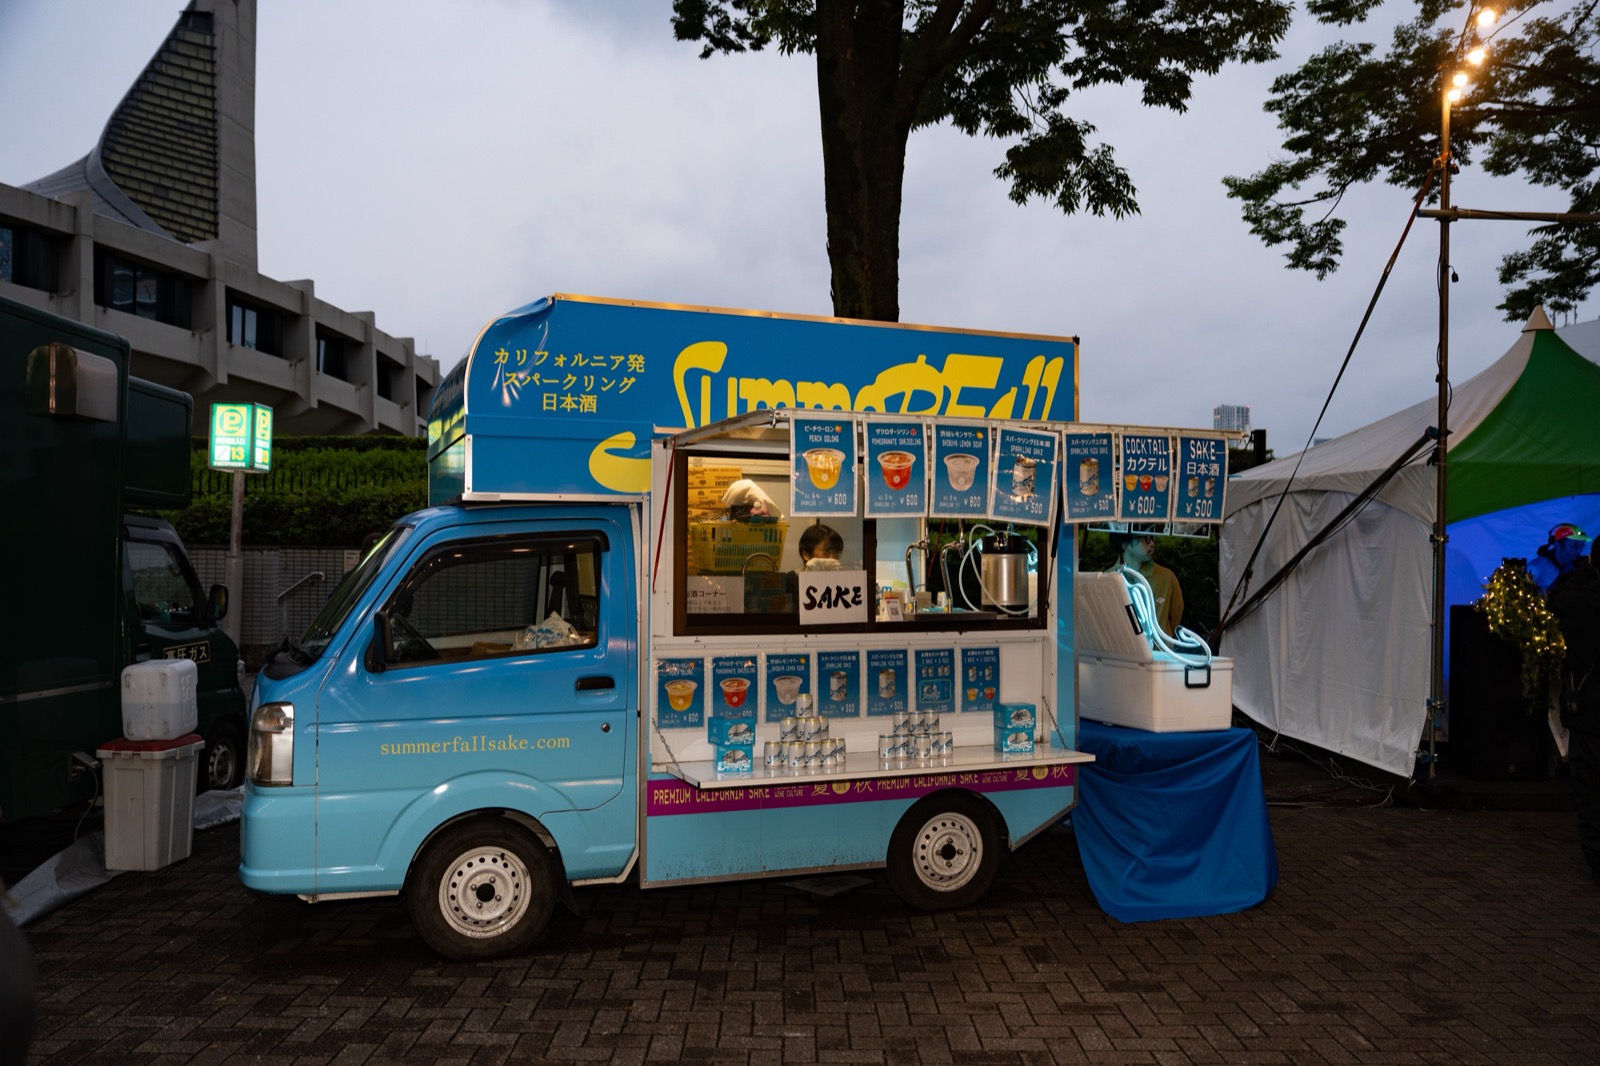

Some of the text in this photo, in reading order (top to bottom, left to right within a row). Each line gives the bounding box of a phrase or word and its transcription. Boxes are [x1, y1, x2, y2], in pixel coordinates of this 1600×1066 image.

[494, 347, 646, 373] カリフォルニア発
[503, 371, 637, 394] スパークリング
[541, 393, 598, 413] 日本酒
[808, 434, 823, 443] PEACH
[1125, 438, 1168, 455] COCKTAIL
[1189, 440, 1216, 460] SAKE
[1127, 457, 1168, 471] カクテル
[1186, 461, 1220, 477] 日本酒
[803, 585, 863, 611] SAKE
[380, 734, 571, 755] summerfallsake.com
[877, 773, 979, 791] PREMIUM CALIFORNIA SAKE
[653, 787, 770, 805] PREMIUM CALIFORNIA SAKE
